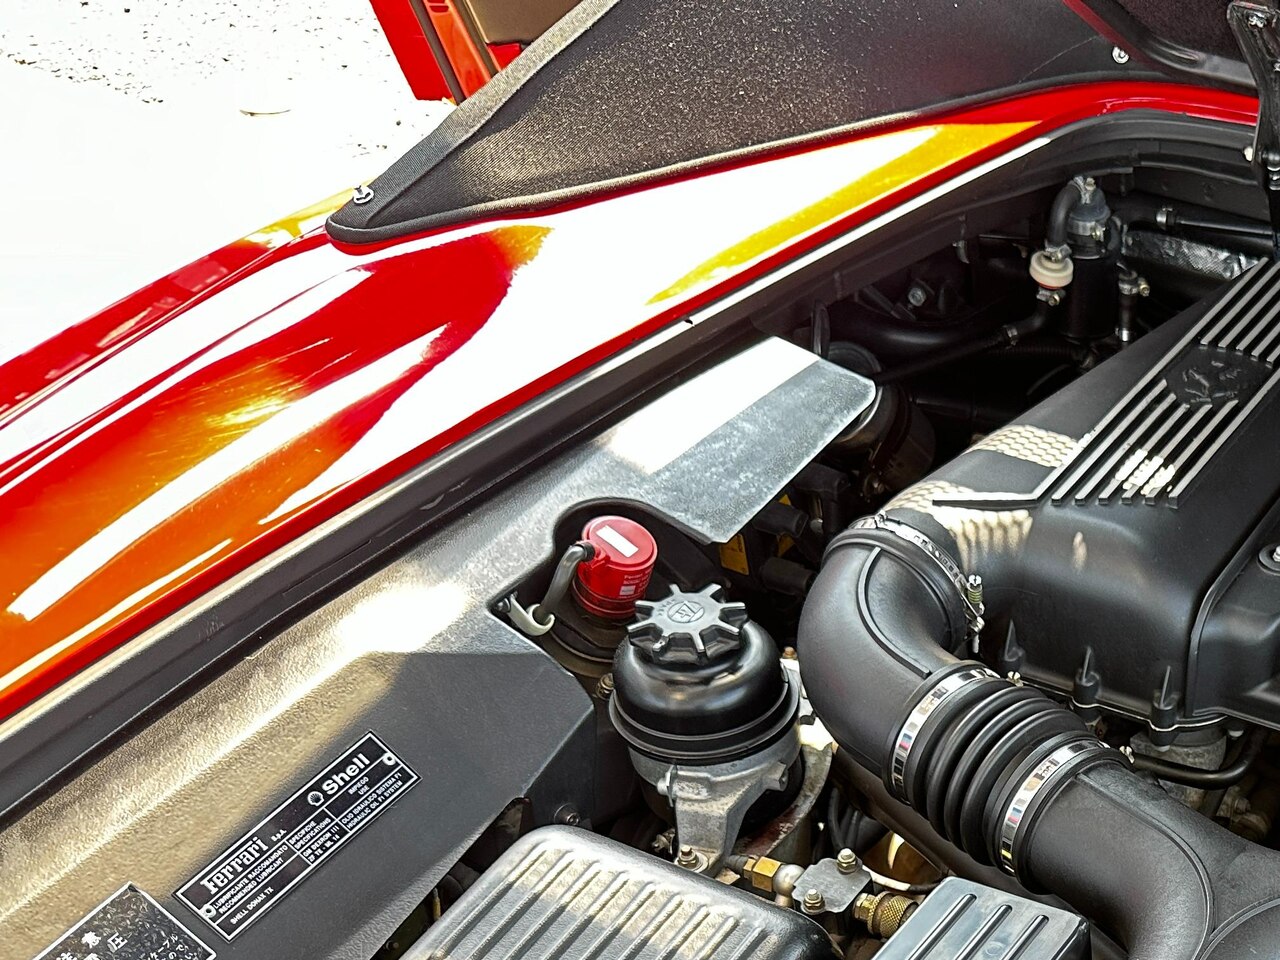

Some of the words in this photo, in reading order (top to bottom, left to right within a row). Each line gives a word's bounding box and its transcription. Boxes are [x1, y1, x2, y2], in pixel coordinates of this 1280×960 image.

[319, 752, 371, 796] Shell
[347, 775, 370, 795] IMPIEGO
[357, 784, 370, 795] USE
[340, 812, 354, 824] OLIO
[351, 792, 378, 814] IDRAULICO
[375, 776, 397, 795] SISTEMA
[369, 800, 380, 809] OIL
[383, 779, 403, 797] SYSTEM
[288, 820, 317, 845] SPECIFICHE
[293, 816, 332, 849] SPECIFICATIONS
[198, 835, 269, 895] Ferrari
[211, 877, 249, 909] LUBRIFICANTE
[246, 844, 288, 879] RACCOMANDATO
[217, 879, 258, 914] RECOMMENDED
[254, 856, 285, 882] LUBRICANT
[229, 908, 249, 924] SHELL
[264, 886, 274, 895] TX
